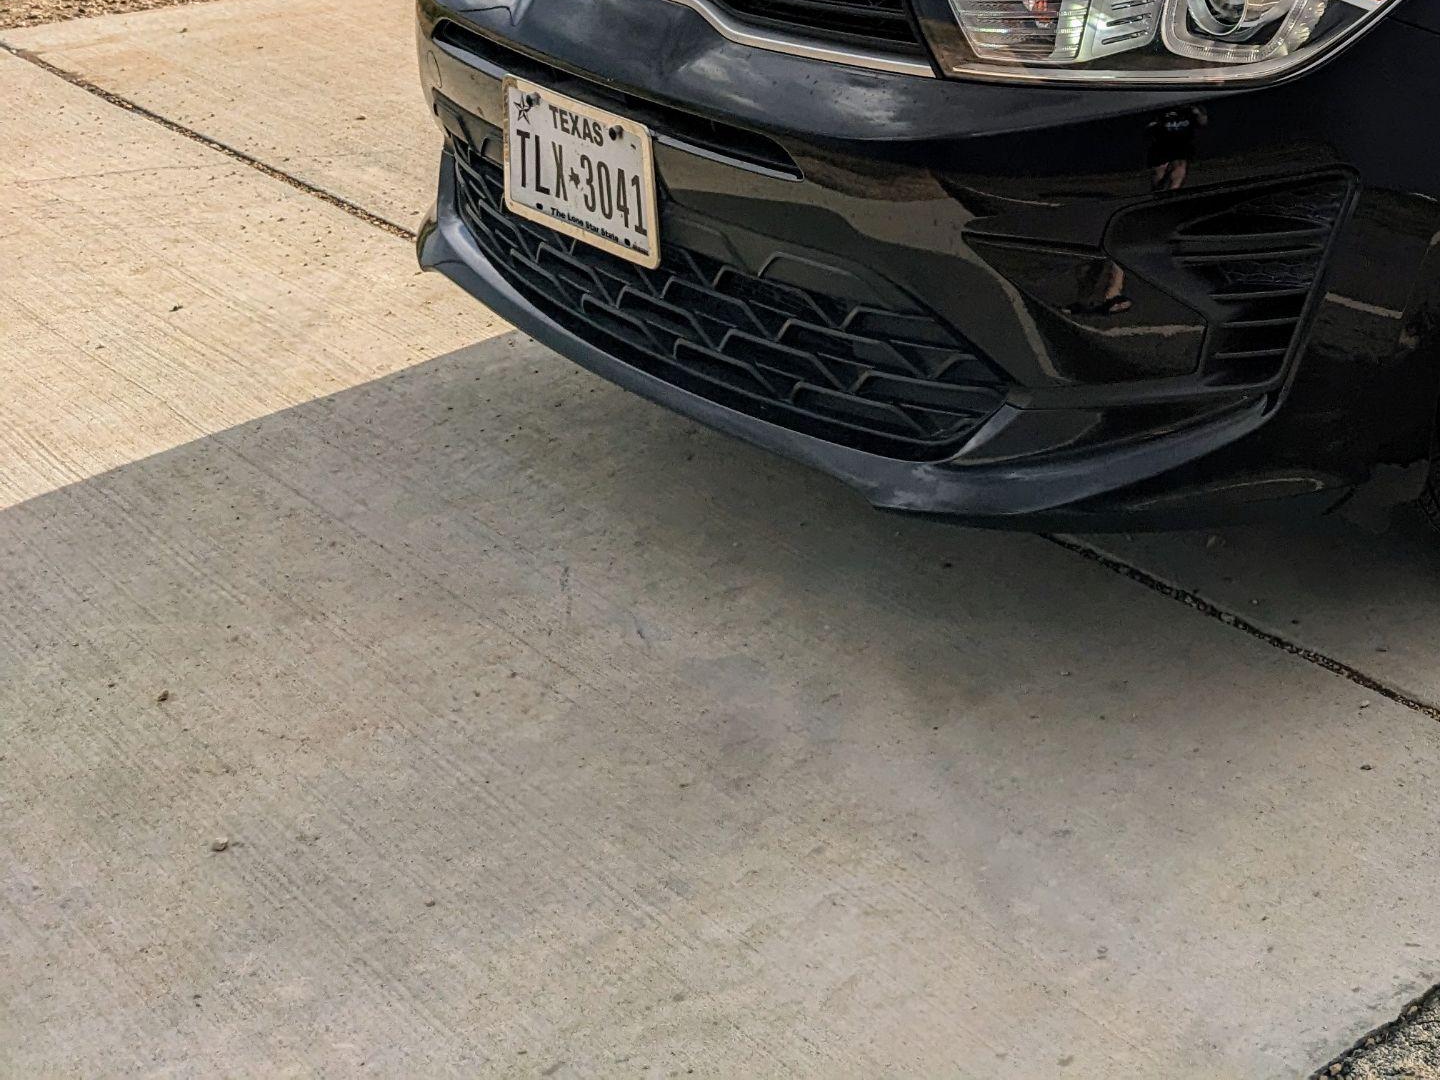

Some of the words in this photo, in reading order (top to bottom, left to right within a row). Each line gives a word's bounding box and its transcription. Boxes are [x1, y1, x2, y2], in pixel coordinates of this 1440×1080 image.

[548, 104, 604, 147] TEXAS
[516, 128, 569, 202] TLX
[579, 154, 648, 237] 3041
[550, 206, 566, 220] The
[567, 212, 584, 226] Lone
[585, 220, 600, 233] Star
[600, 227, 619, 243] State
